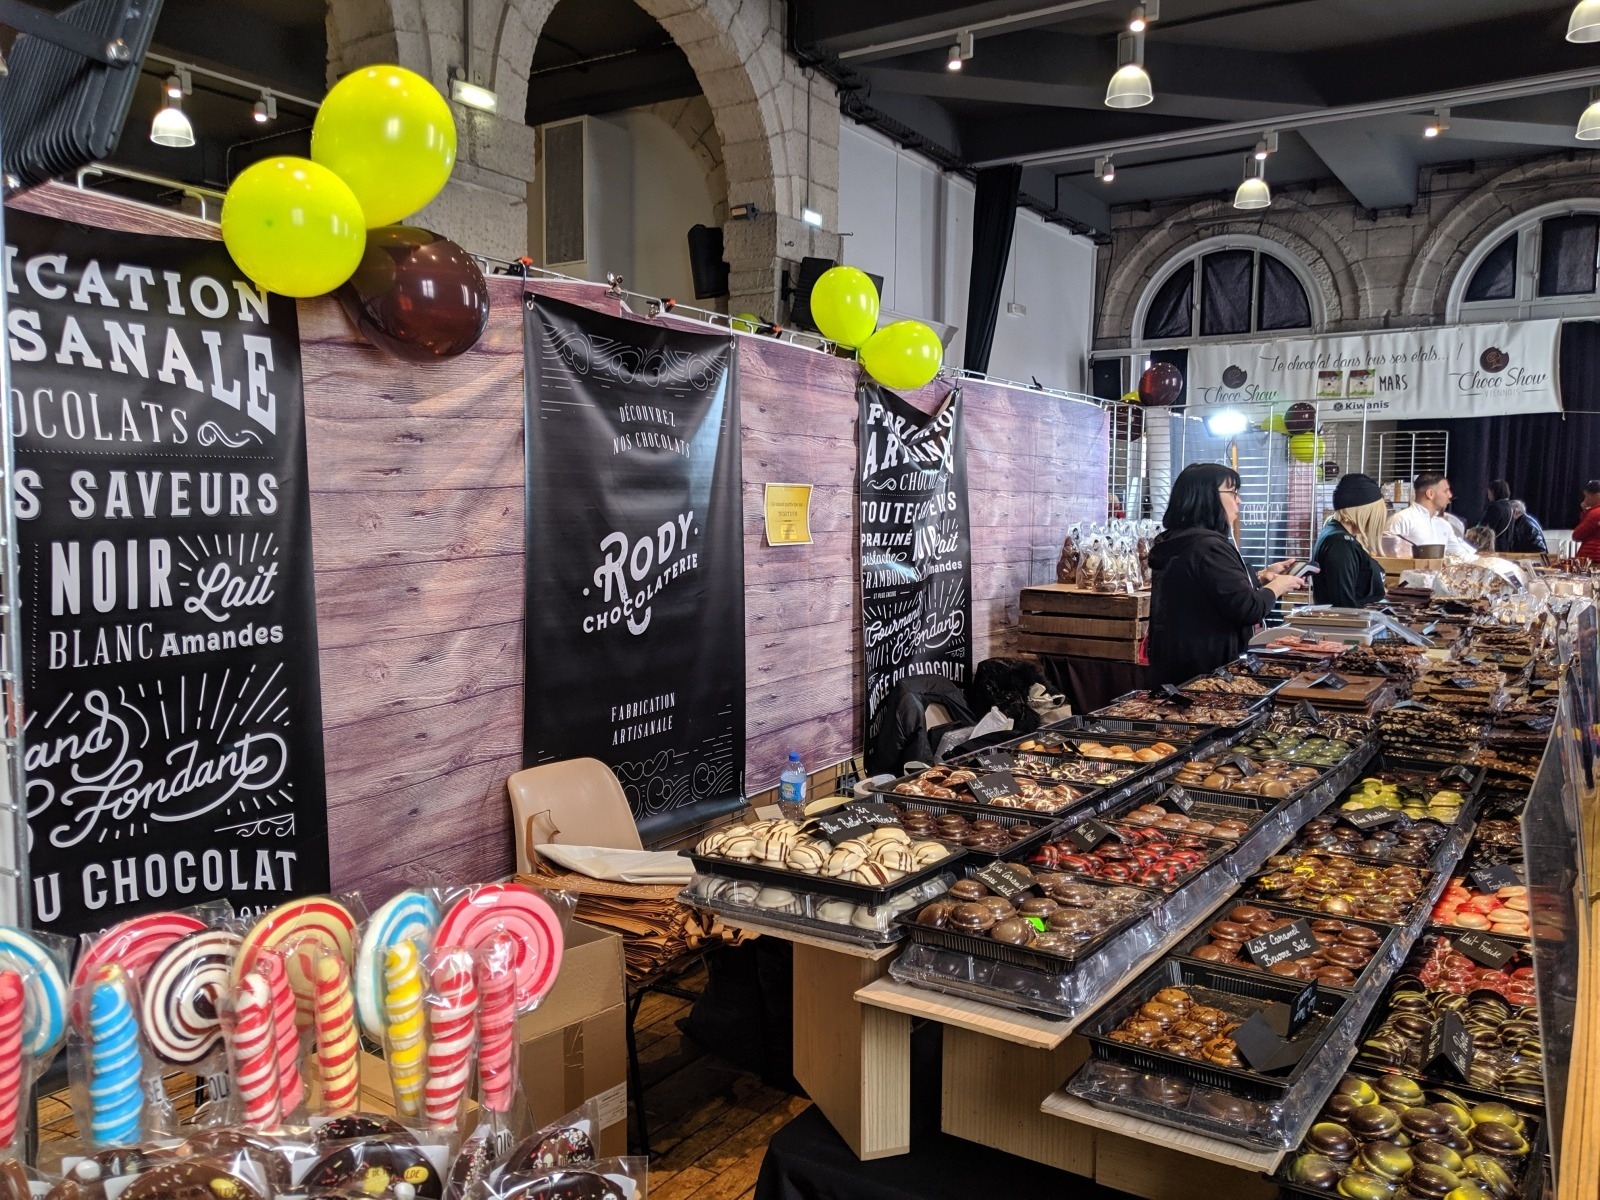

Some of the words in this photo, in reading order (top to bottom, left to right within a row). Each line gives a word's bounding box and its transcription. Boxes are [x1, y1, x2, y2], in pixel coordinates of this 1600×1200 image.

[8, 308, 277, 435] SANALE
[1287, 353, 1331, 371] chocolat
[1333, 352, 1361, 368] dans
[1365, 350, 1386, 366] tous
[1390, 354, 1408, 365] ses
[1198, 386, 1240, 404] Choco
[1243, 383, 1278, 402] Show
[1379, 374, 1408, 391] MARS
[1450, 371, 1502, 391] Choco
[1505, 367, 1548, 387] Show
[618, 403, 676, 428] DÉCOUVREZ
[1345, 401, 1390, 410] Kiwanis
[613, 435, 632, 455] NOS
[635, 432, 690, 458] CHOCOLATS
[69, 470, 279, 520] SAVEURS
[861, 529, 913, 548] PRALINÉ
[51, 539, 173, 616] NOIR
[184, 562, 278, 622] Lait
[582, 553, 699, 634] CHOCOLATERIE
[48, 623, 154, 669] BLANC
[160, 623, 283, 657] Amandes
[611, 692, 676, 722] FABRICATION
[612, 715, 674, 746] ARTISANALE
[49, 733, 287, 848] Fondant
[82, 849, 297, 910] CHOCOLAT
[1248, 939, 1268, 955] Lait
[1269, 923, 1300, 946] Caramel
[1292, 937, 1311, 953] Salé
[1460, 931, 1479, 947] Lait
[1478, 940, 1503, 959] Fraise
